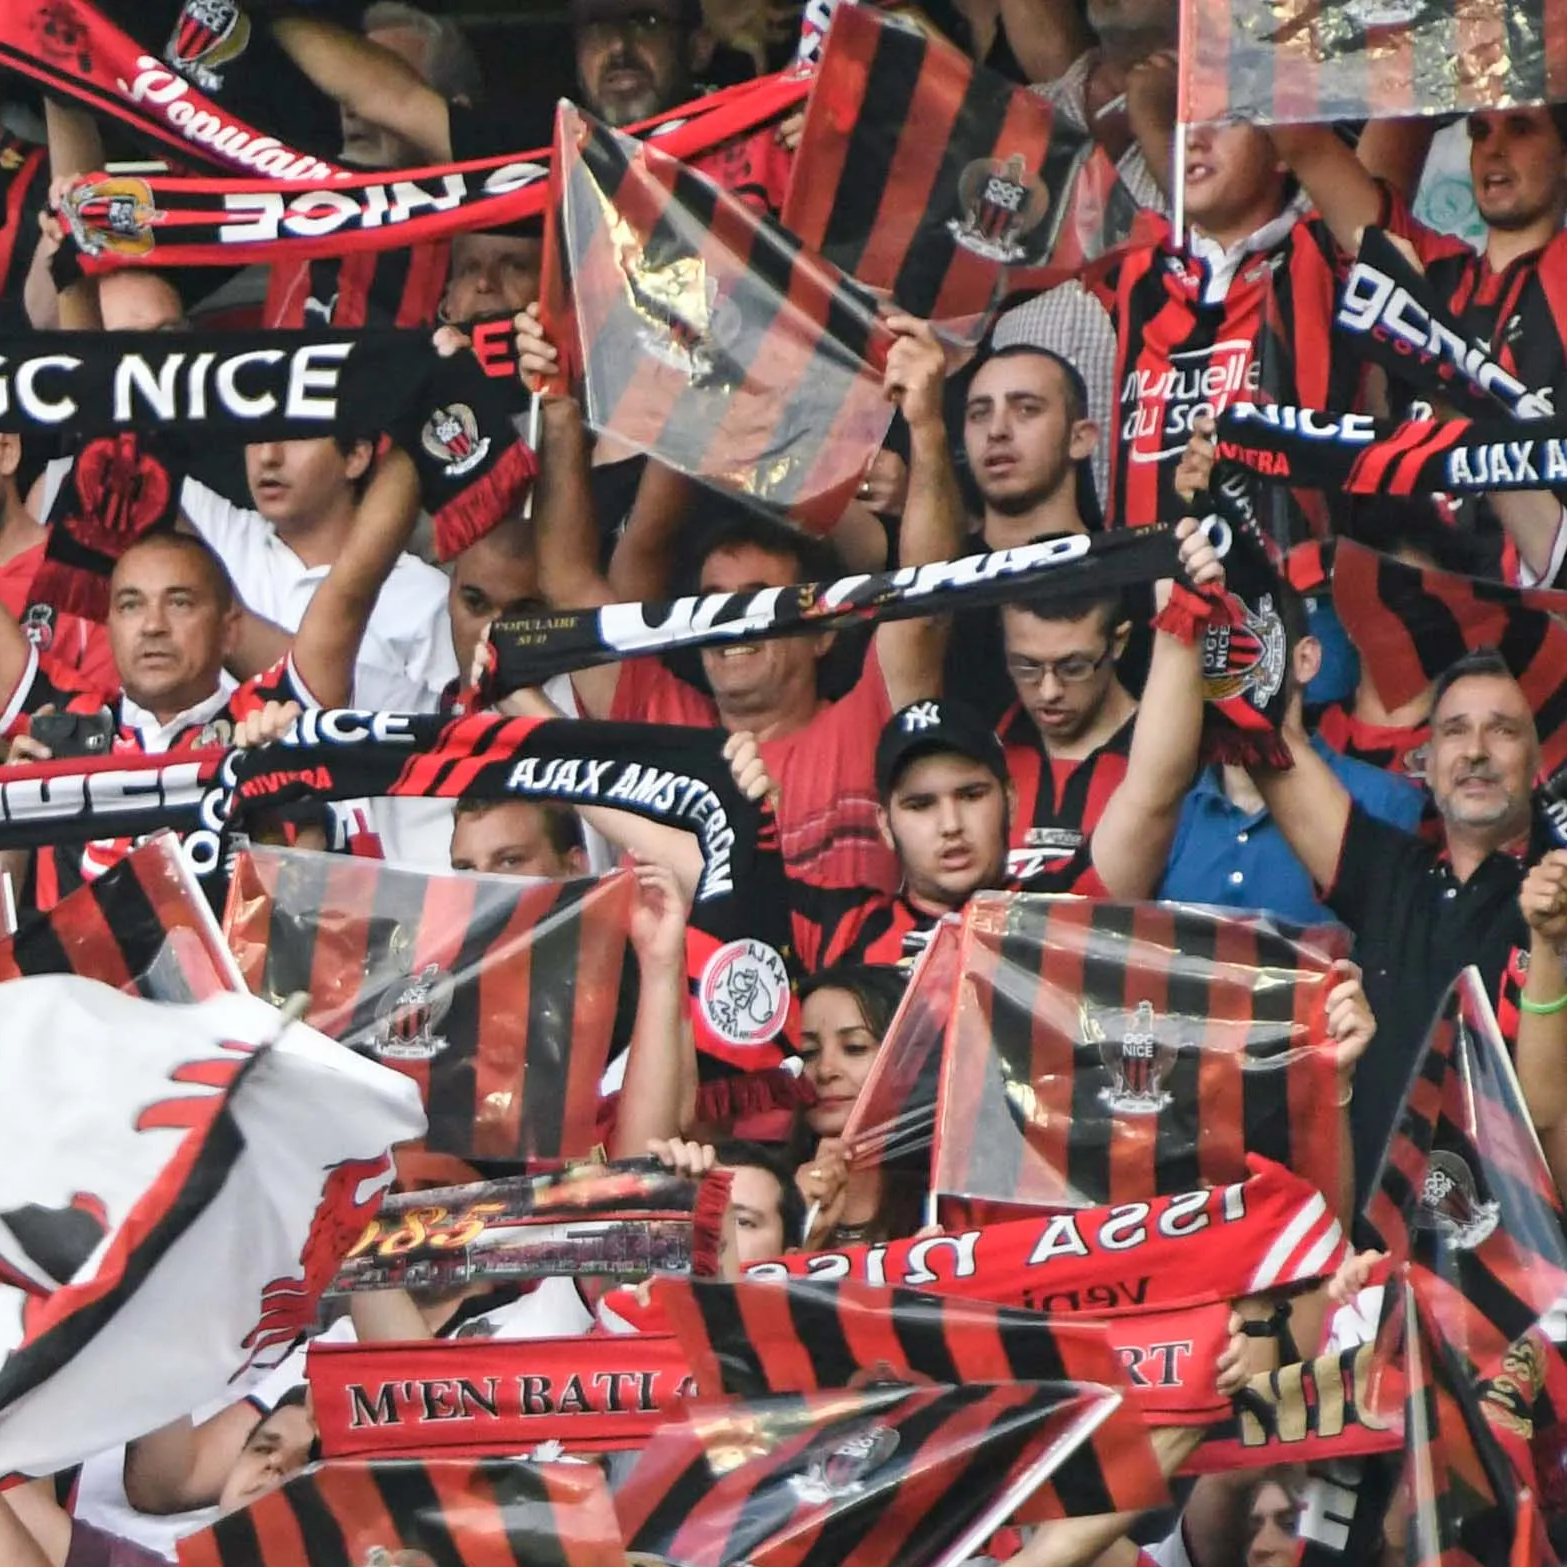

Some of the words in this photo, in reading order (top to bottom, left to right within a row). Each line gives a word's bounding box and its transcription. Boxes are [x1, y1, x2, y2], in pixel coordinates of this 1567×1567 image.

[113, 342, 355, 421] NICE
[1447, 439, 1536, 486] AJAX
[507, 756, 601, 796] AJAX
[607, 760, 736, 902] AMSTERDAM
[347, 1377, 499, 1431] M'EN
[517, 1369, 663, 1419] BATI
